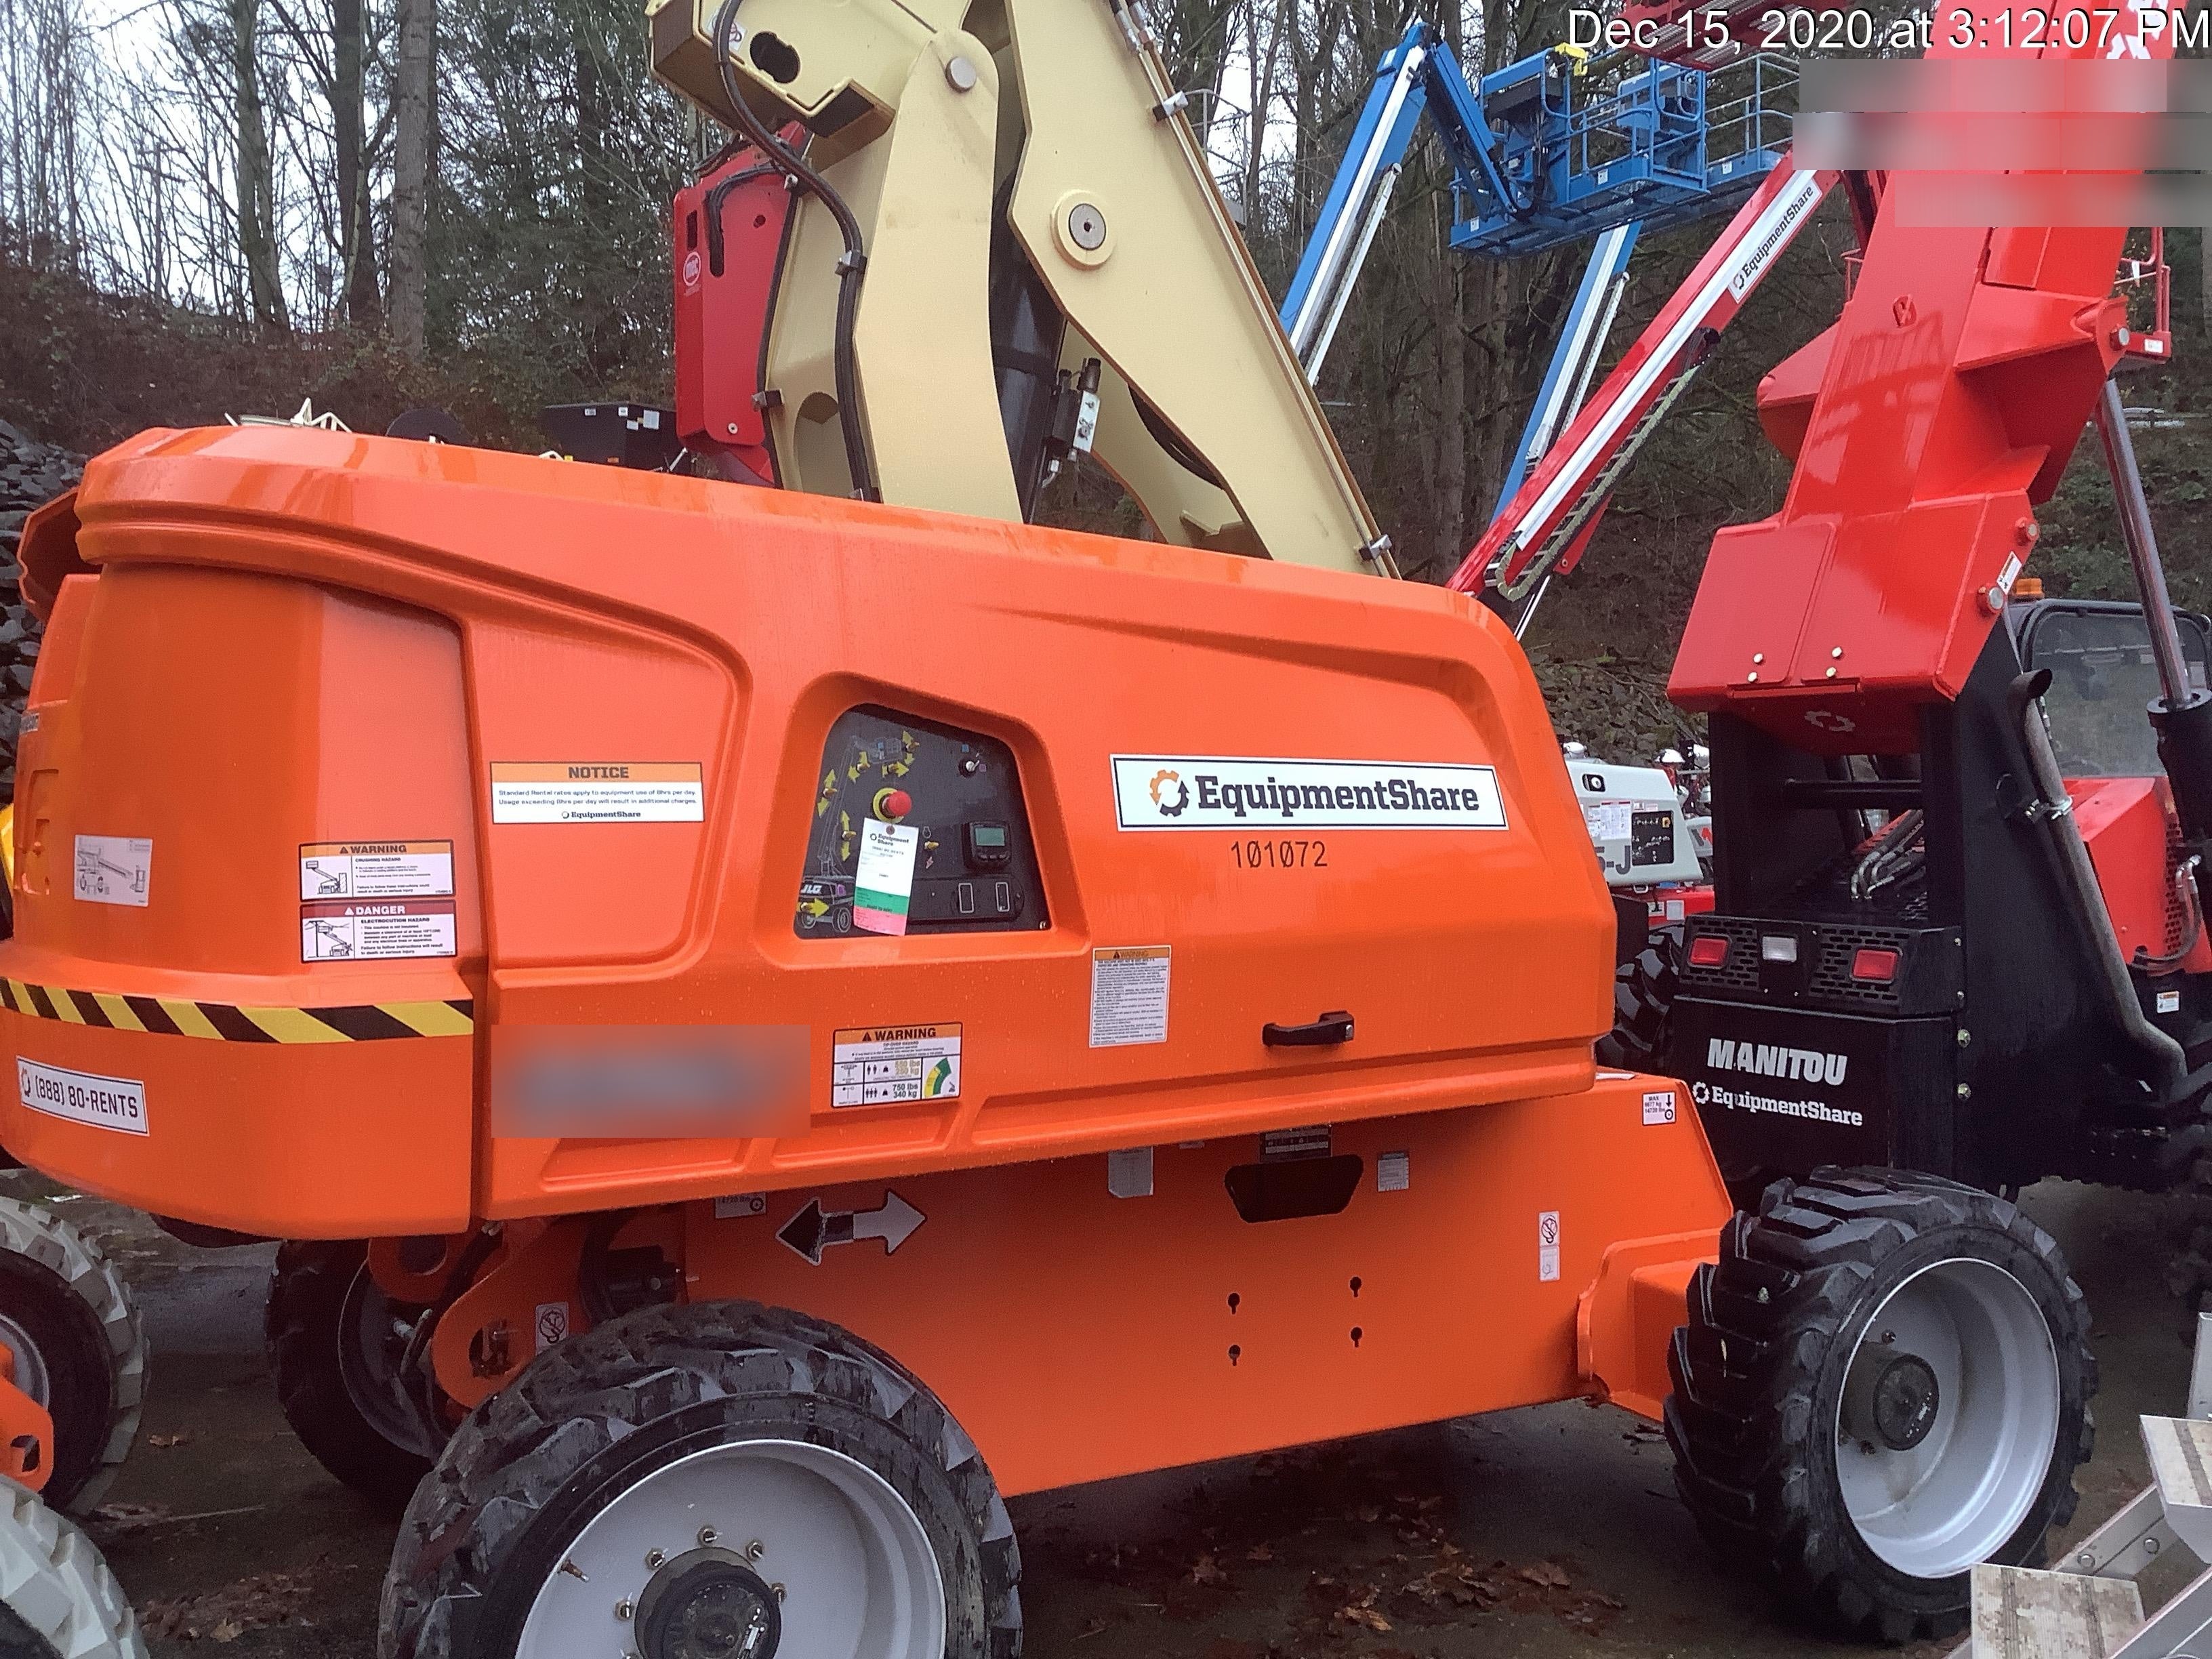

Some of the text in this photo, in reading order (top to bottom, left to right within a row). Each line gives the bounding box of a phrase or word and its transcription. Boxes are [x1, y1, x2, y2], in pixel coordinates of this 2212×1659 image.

[1741, 186, 1814, 278] EquipmentShare
[569, 766, 629, 779] NOTICE
[1195, 775, 1479, 817] EquipmentShare
[571, 811, 641, 819] EquipmentShare
[350, 845, 407, 854] WARNING
[1231, 840, 1328, 868] 101072
[800, 884, 822, 895] JLG
[356, 905, 405, 915] DANGER
[875, 1027, 936, 1041] WARNING
[1707, 1038, 1848, 1086] MANITOU
[35, 1075, 138, 1118] (888) 80-RENTS
[893, 1090, 917, 1099] 340 kg
[1711, 1086, 1863, 1126] EquipmentShare
